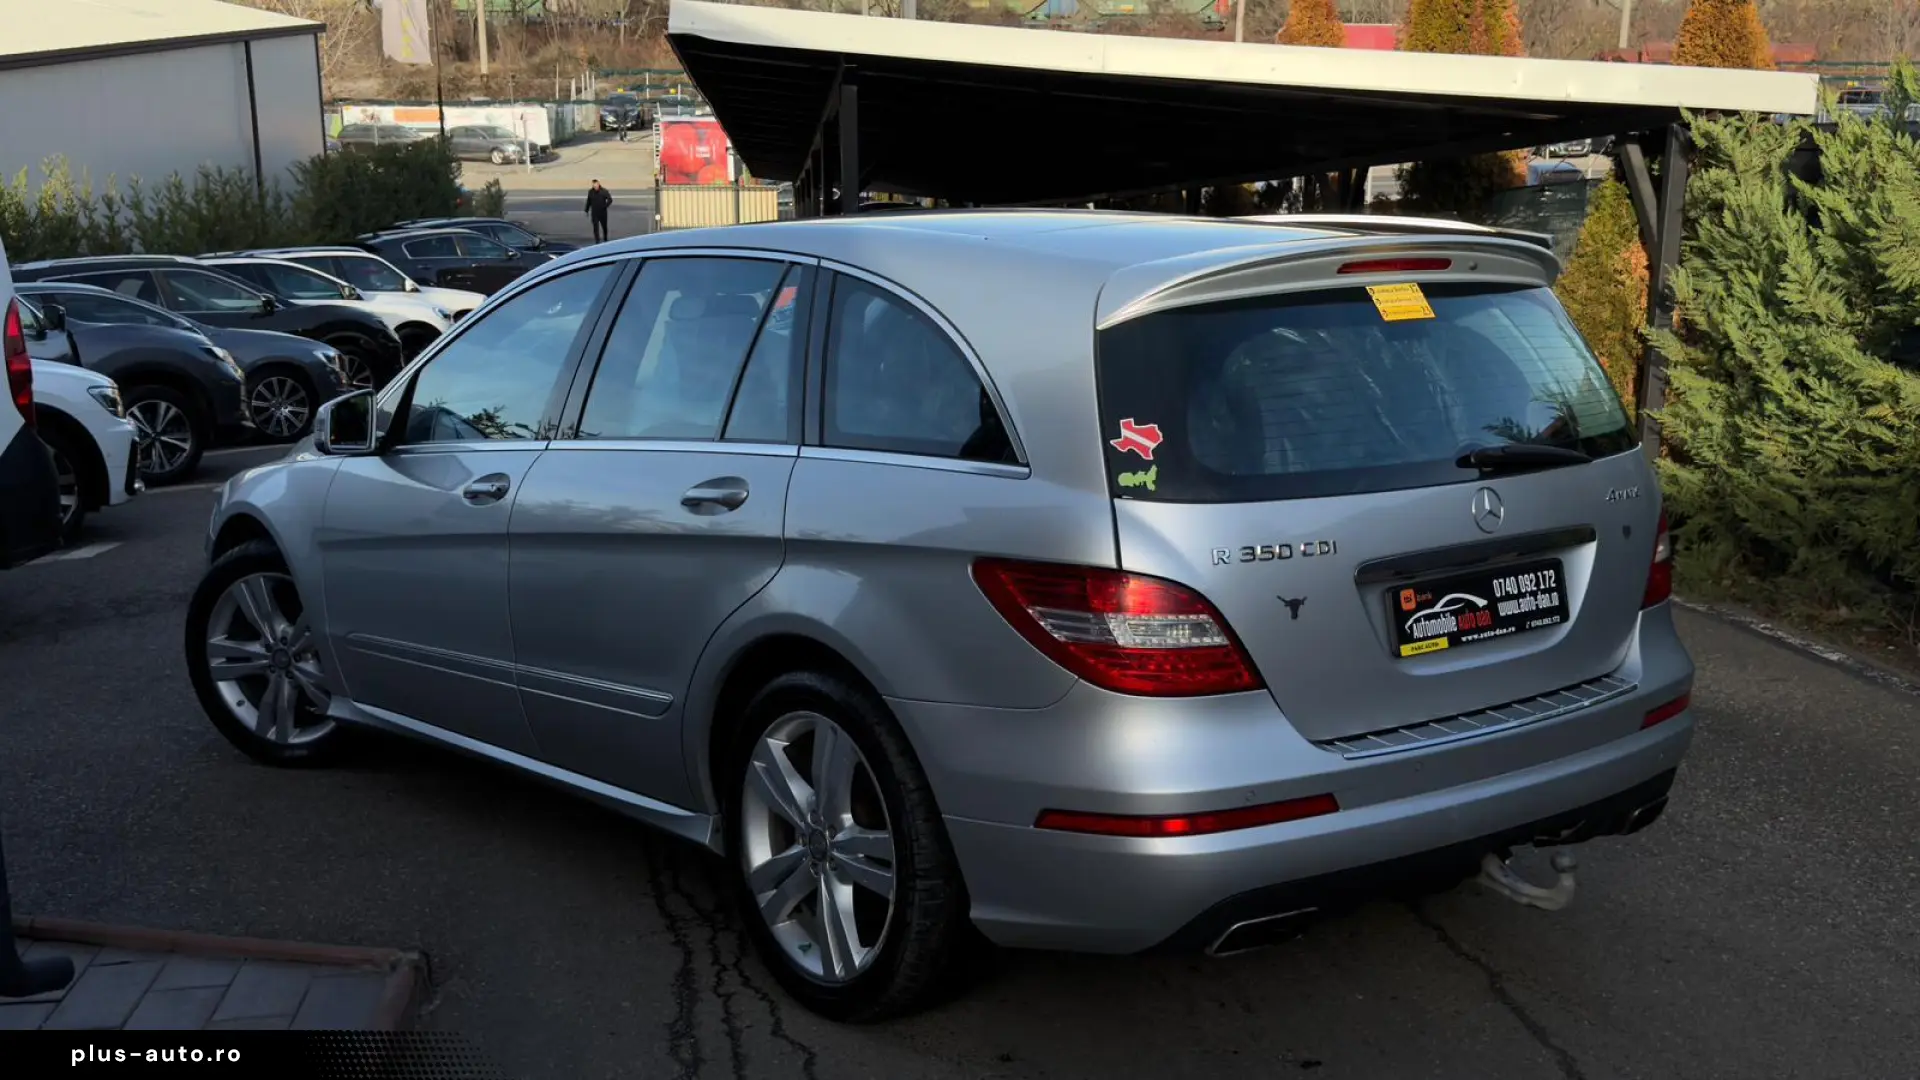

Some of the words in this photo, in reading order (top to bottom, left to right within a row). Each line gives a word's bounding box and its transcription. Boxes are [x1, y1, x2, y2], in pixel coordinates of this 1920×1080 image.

[1211, 547, 1231, 566] R
[1239, 543, 1293, 563] 350
[1300, 540, 1338, 557] CDI
[1493, 576, 1518, 598] 0740
[1518, 573, 1538, 594] 092
[1537, 569, 1557, 590] 172
